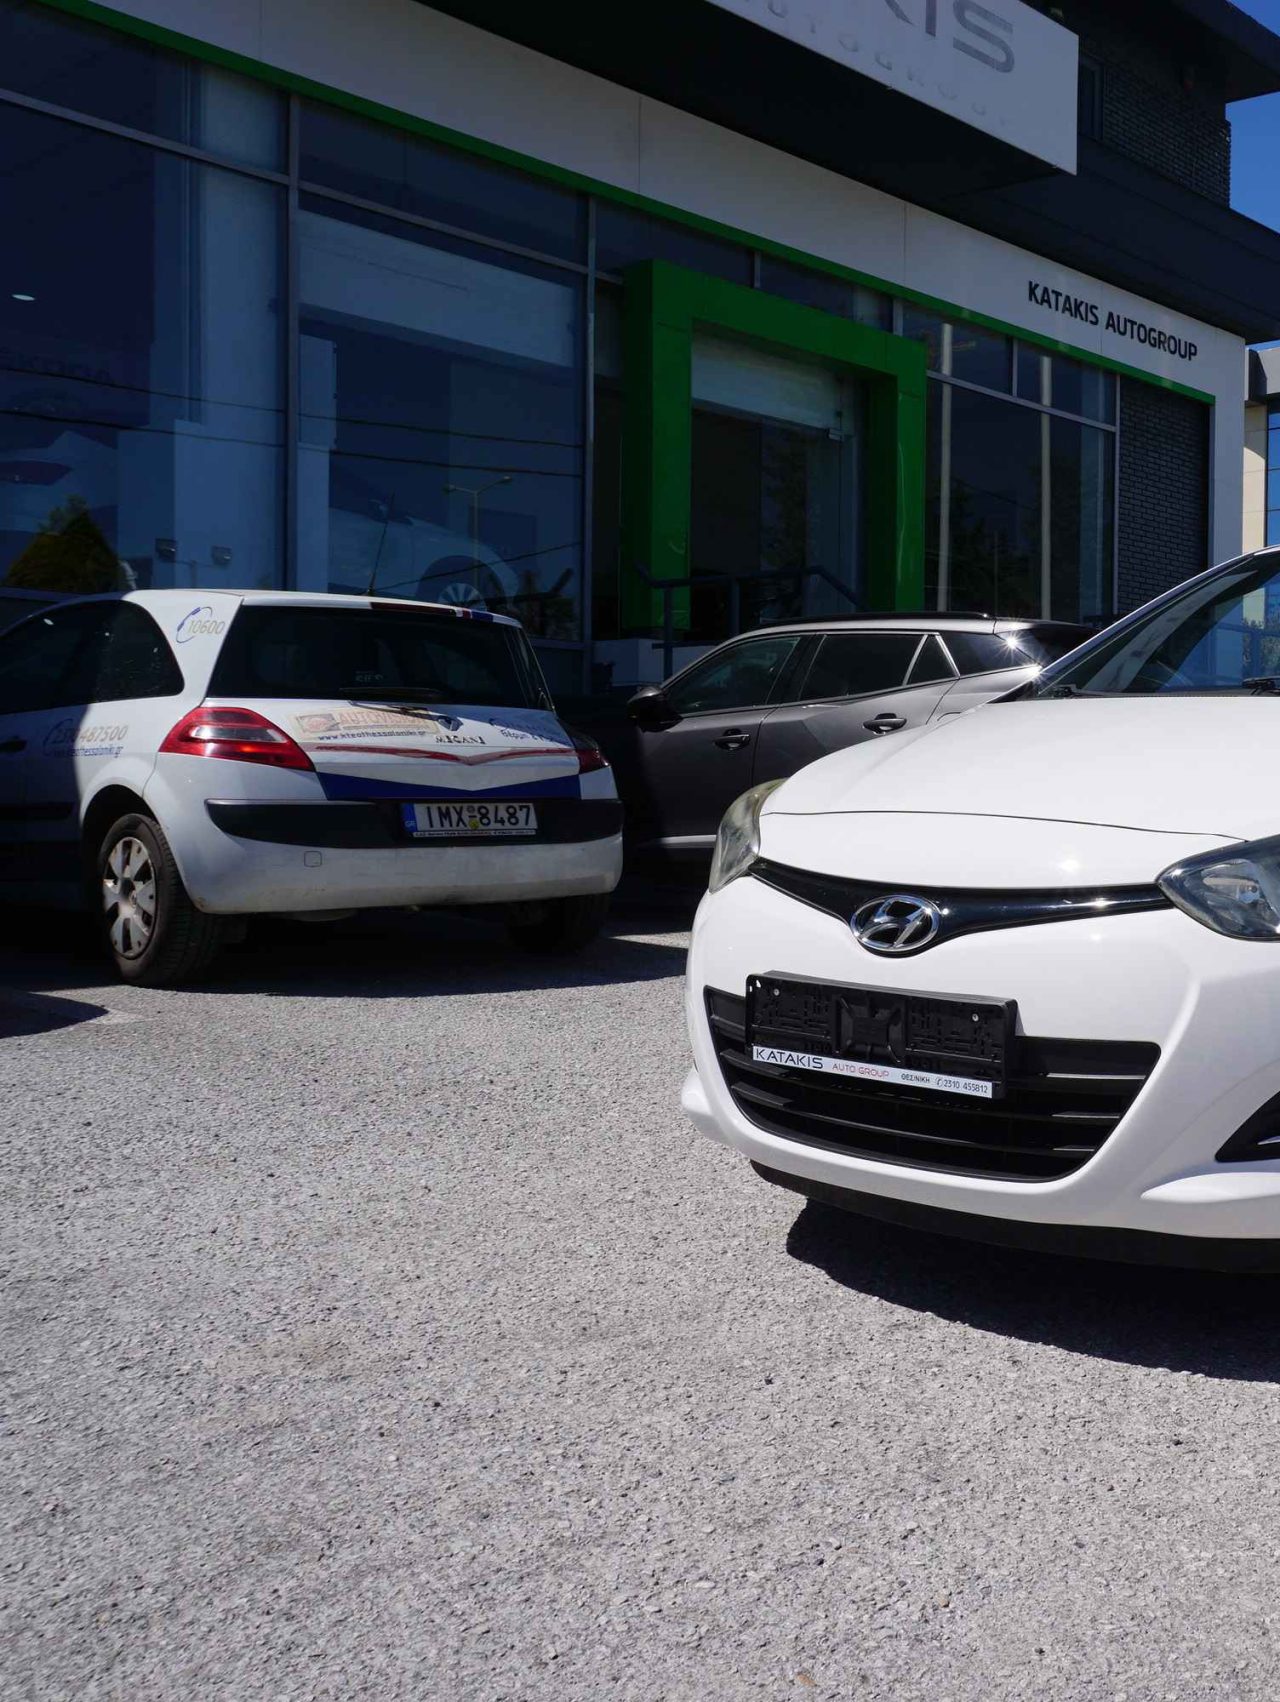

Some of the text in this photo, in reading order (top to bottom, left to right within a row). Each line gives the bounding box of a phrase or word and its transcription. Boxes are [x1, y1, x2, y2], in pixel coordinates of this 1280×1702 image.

[1028, 281, 1198, 361] KATAKIS AUTOGROUP
[188, 619, 226, 635] 10600
[756, 1048, 824, 1070] KATAKIS
[832, 1062, 857, 1075] AUTO
[858, 1066, 890, 1079] GROUP
[943, 1079, 961, 1090] 2310
[962, 1081, 988, 1094] 455812
